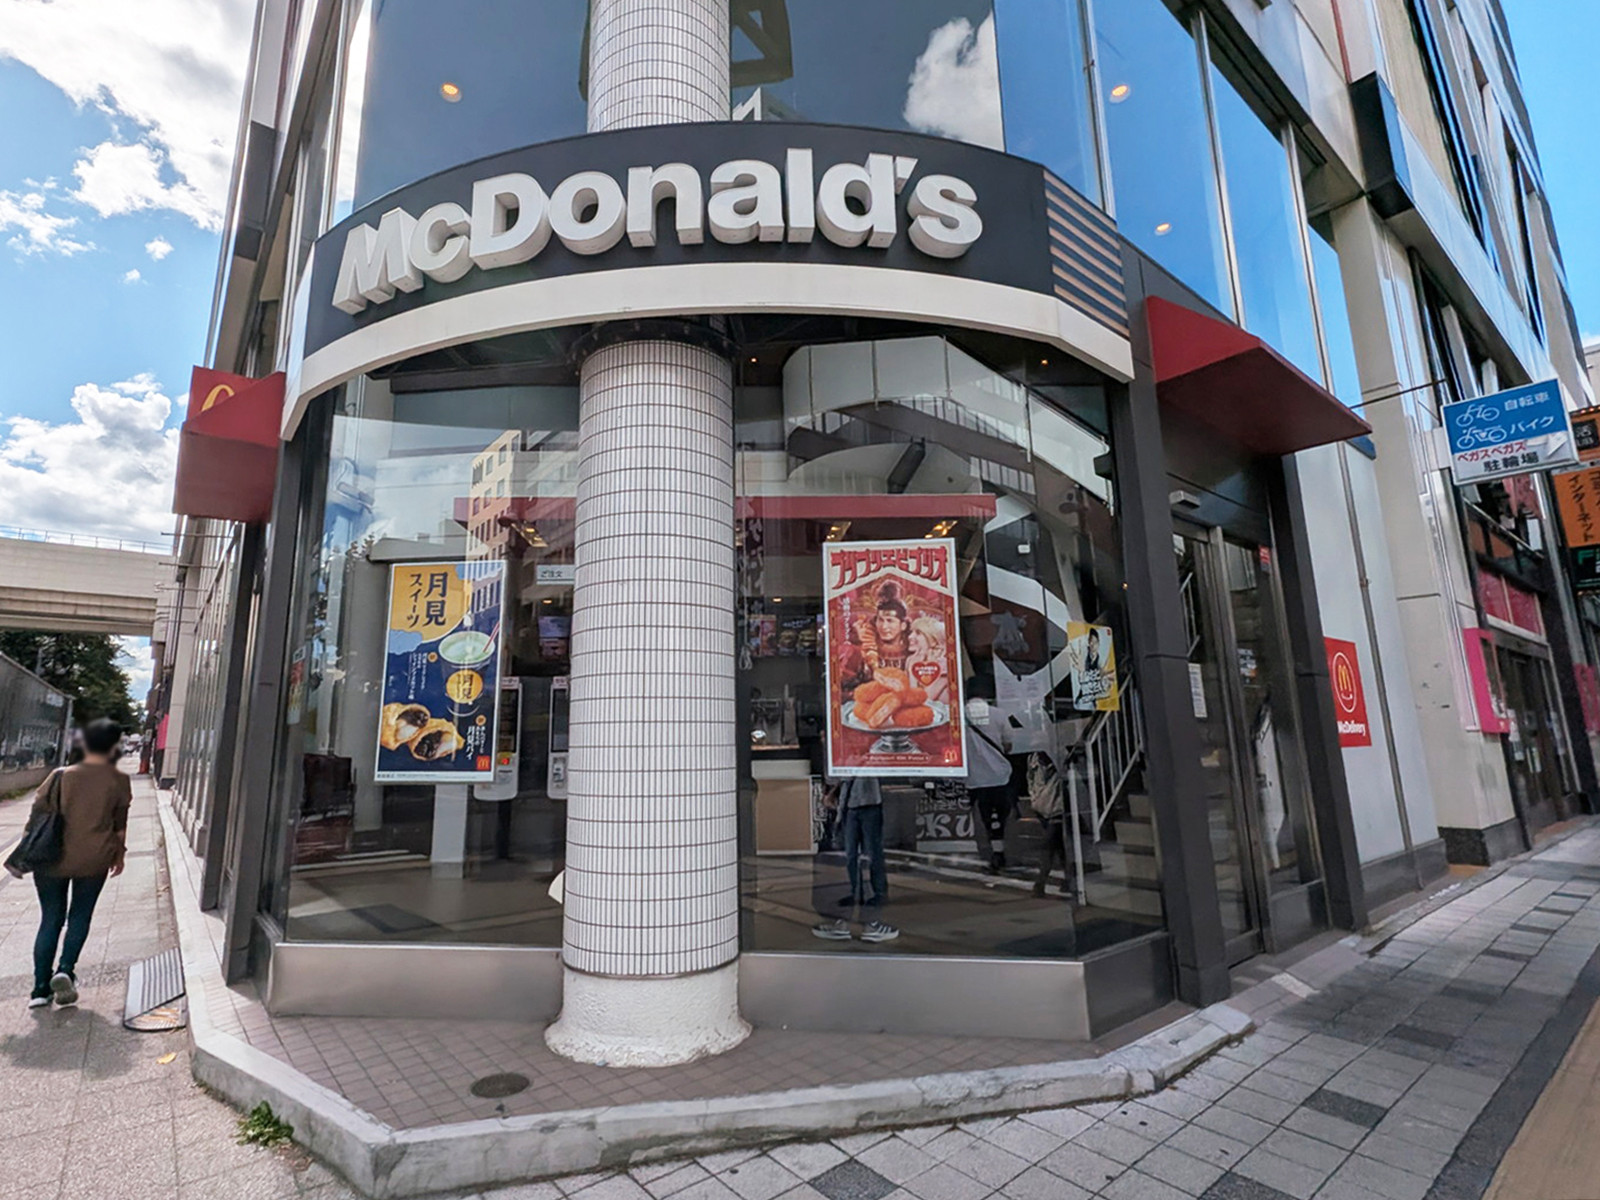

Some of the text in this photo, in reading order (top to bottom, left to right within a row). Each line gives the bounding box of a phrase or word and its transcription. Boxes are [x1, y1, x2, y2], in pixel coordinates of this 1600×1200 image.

[332, 148, 983, 315] McDonald's
[1504, 391, 1551, 412] 自転車
[1510, 415, 1555, 435] バイク
[1457, 441, 1528, 463] ベガスベガス
[1483, 451, 1540, 473] 駐輪場
[1568, 473, 1594, 543] インターネット
[406, 572, 423, 629] スイーツ
[422, 571, 449, 627] 月見
